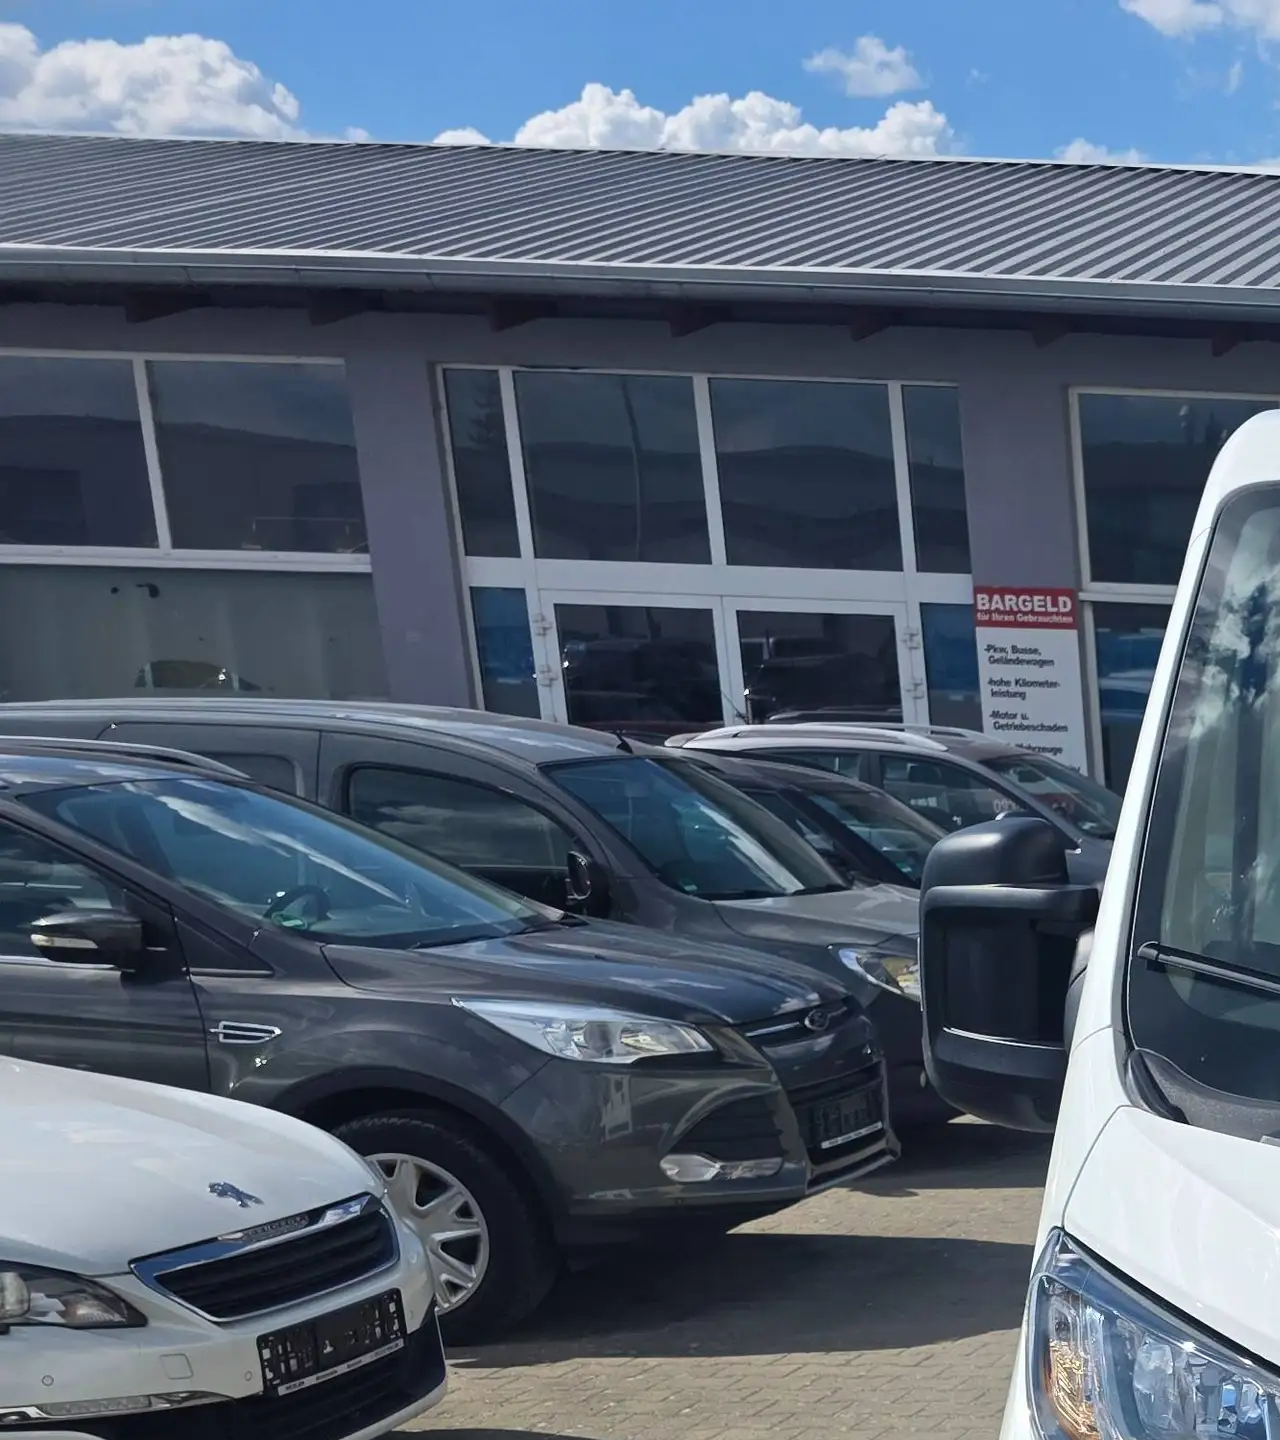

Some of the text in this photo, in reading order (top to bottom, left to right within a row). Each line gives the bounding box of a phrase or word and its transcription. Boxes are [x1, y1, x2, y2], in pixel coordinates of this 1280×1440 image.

[976, 593, 1072, 612] BARGELD
[1016, 613, 1074, 623] Gebrauchten
[988, 655, 1055, 668] Geländewagen
[990, 688, 1027, 701] leistung
[993, 721, 1069, 732] Getriebeschaden
